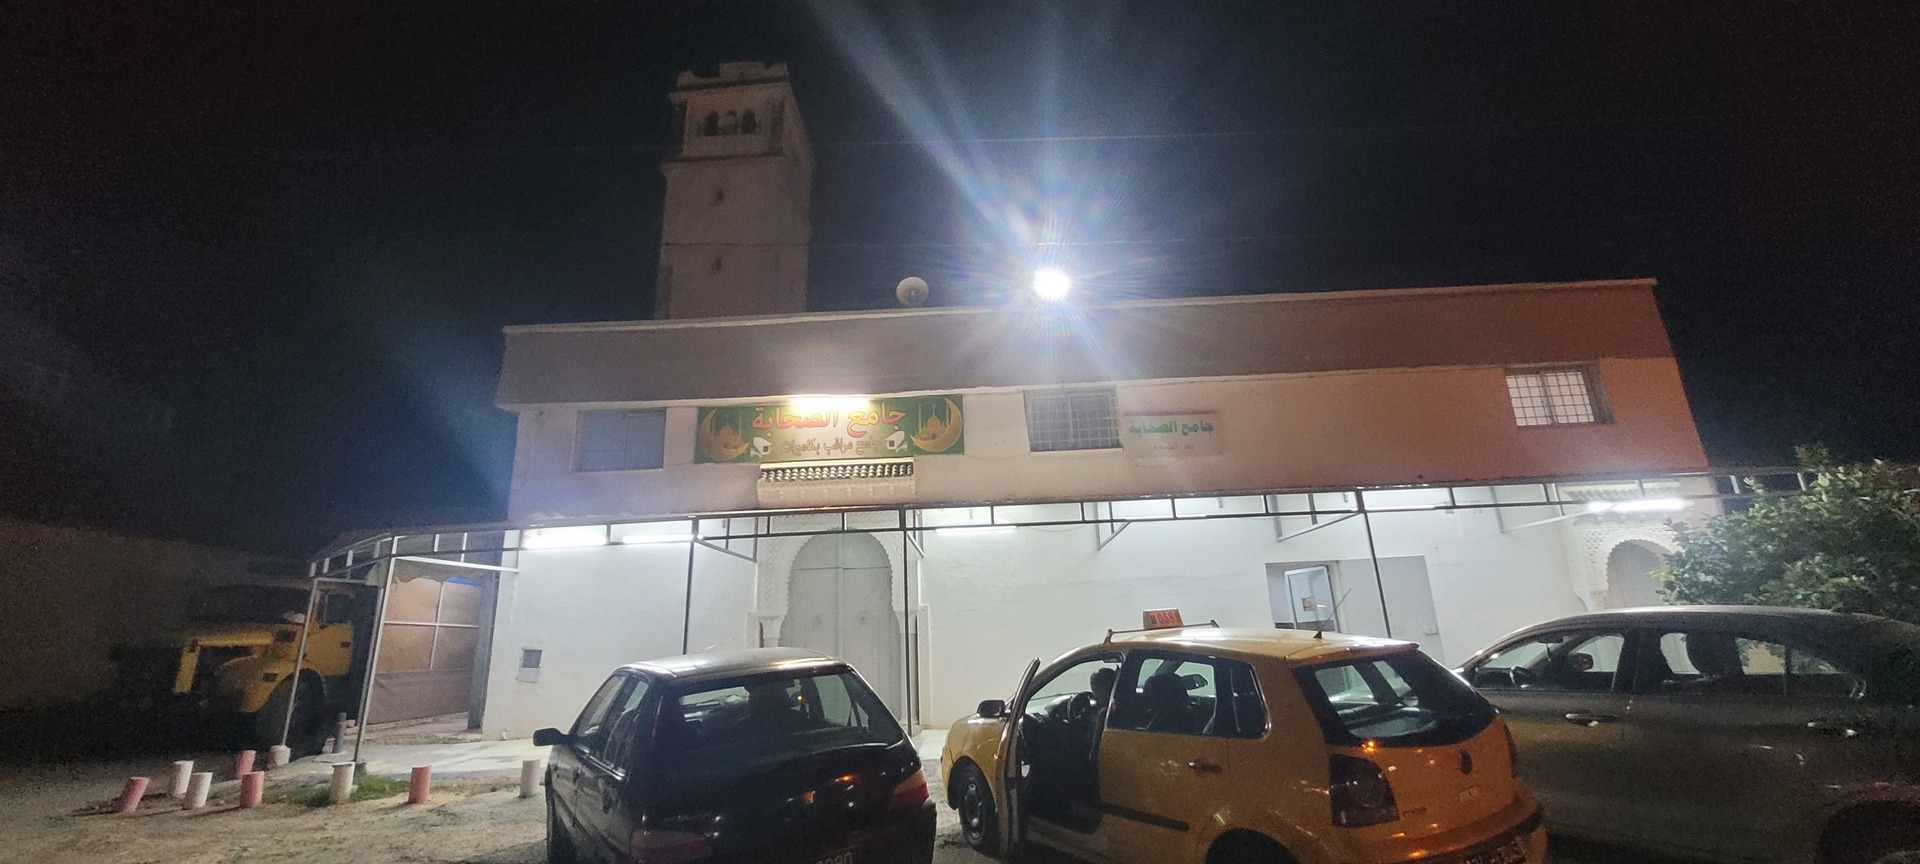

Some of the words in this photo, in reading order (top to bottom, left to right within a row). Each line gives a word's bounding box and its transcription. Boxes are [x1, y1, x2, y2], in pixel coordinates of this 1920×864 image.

[752, 406, 839, 438] الصحابة
[846, 402, 907, 438] جامع
[1129, 419, 1178, 437] الصحابة
[1181, 419, 1214, 436] جامع
[781, 437, 821, 457] بكاميرات
[823, 437, 854, 456] مراقب
[856, 436, 882, 456] جامع
